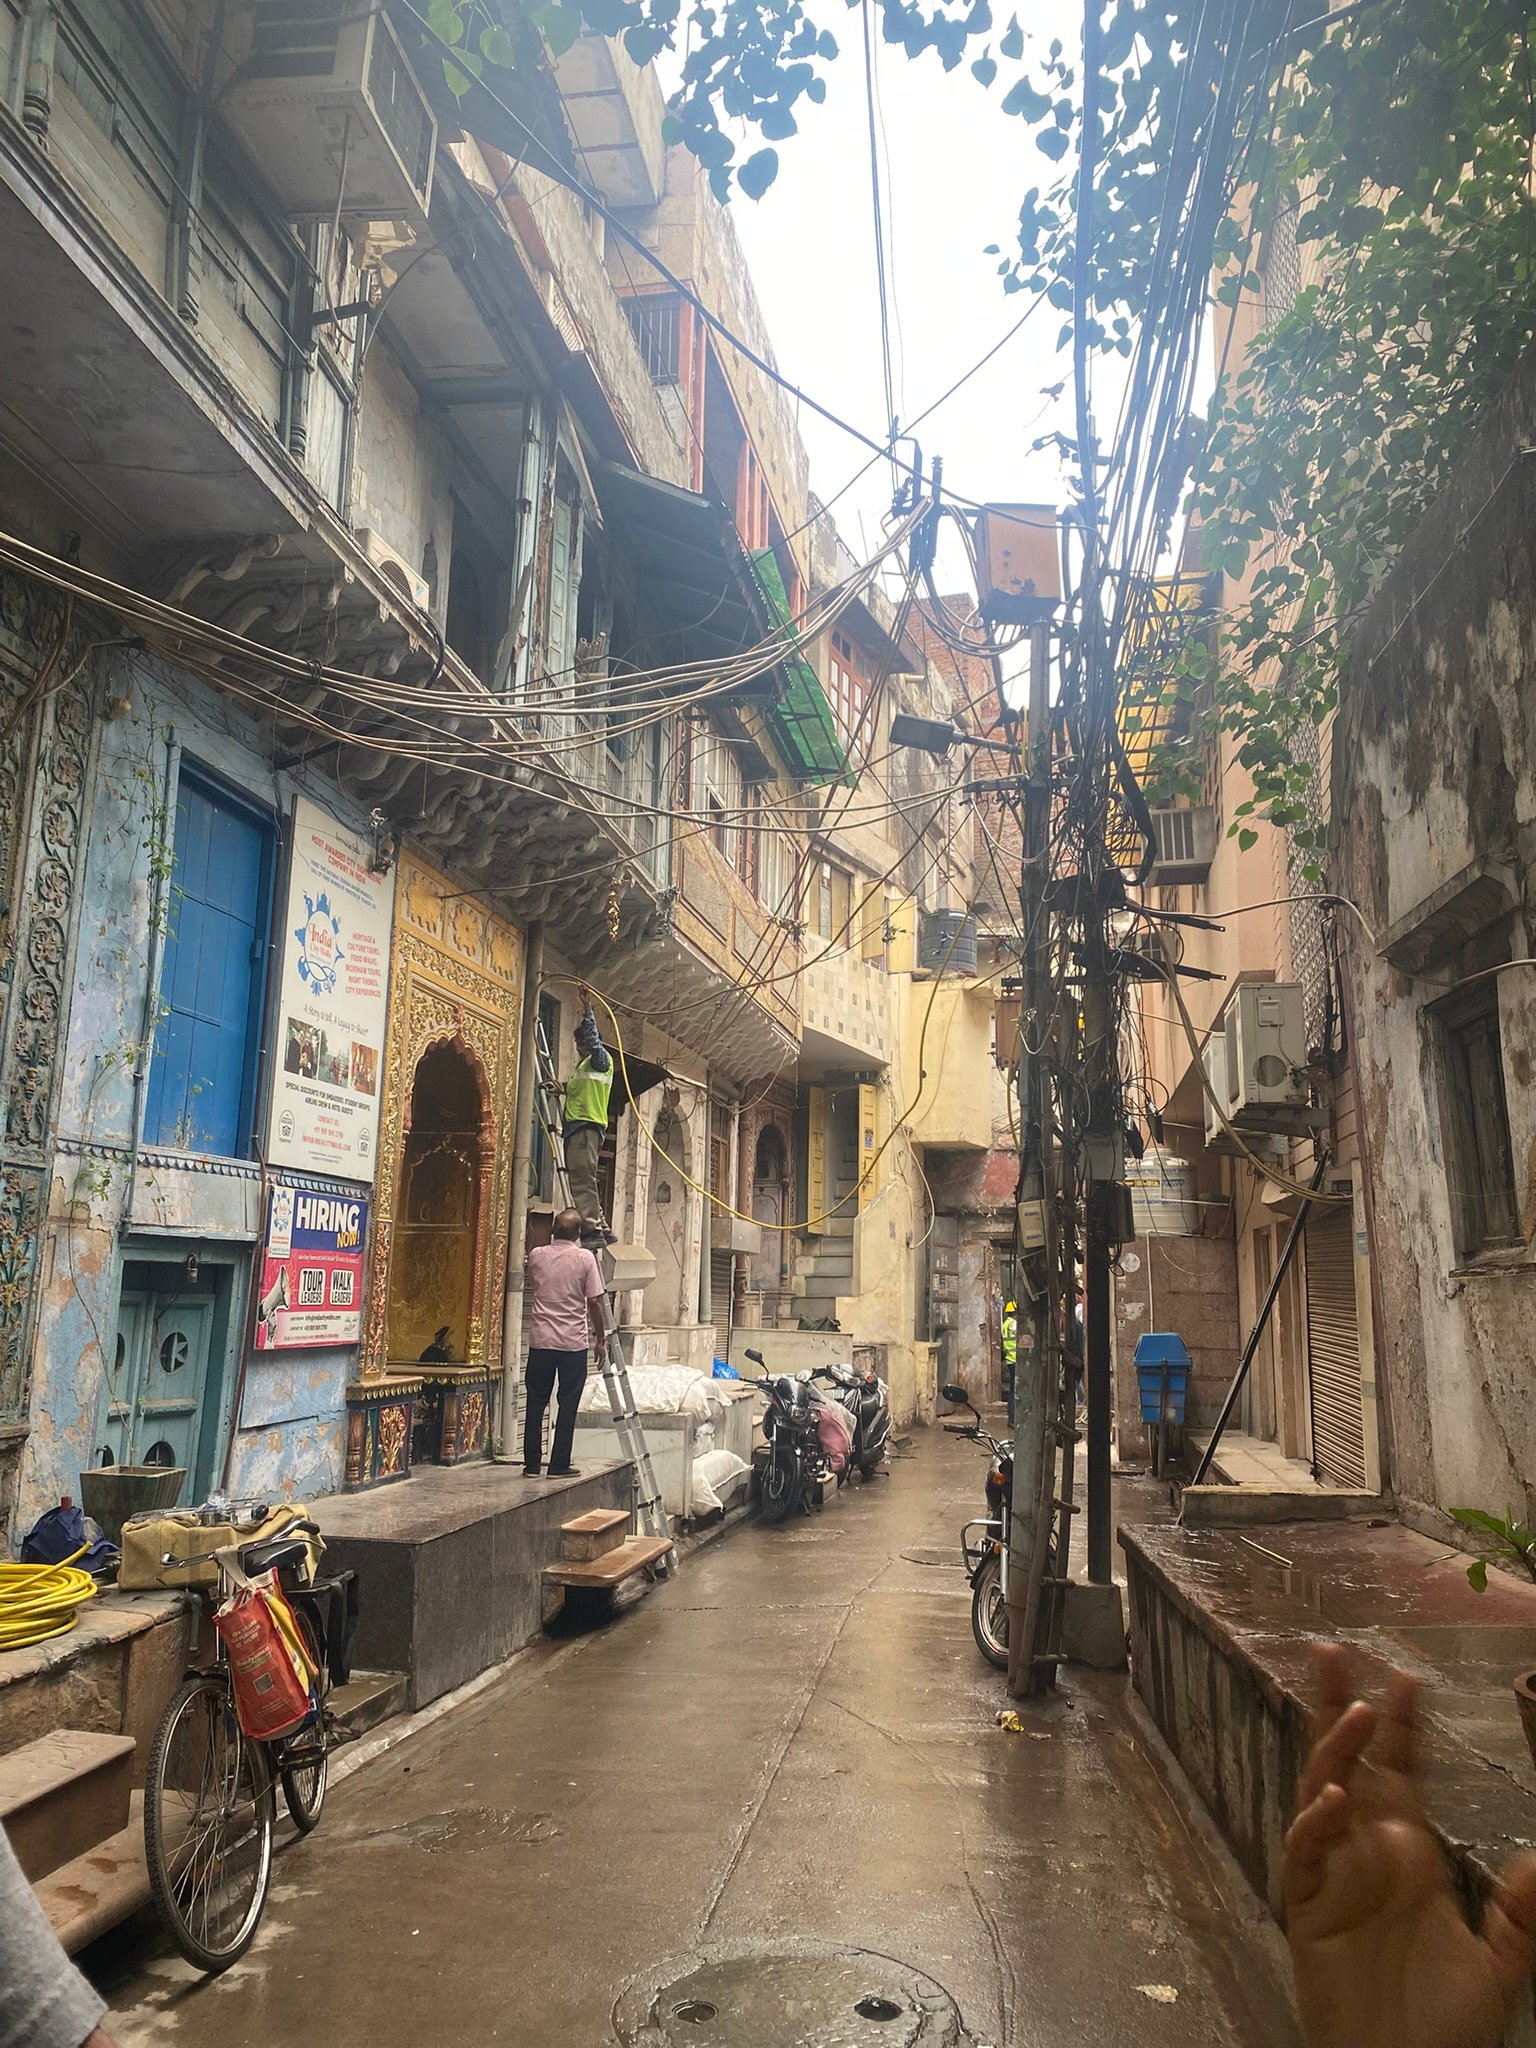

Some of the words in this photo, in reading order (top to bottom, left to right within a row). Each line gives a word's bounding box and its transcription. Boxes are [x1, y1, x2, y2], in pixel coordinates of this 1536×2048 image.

[311, 834, 324, 847] MOST
[325, 843, 346, 862] AWARDED
[346, 857, 356, 868] CITY
[328, 855, 349, 874] COMPANY
[355, 871, 366, 884] INDIA
[309, 923, 332, 950] India
[352, 932, 372, 944] HERITAGE
[347, 942, 366, 953] CULTURE
[351, 954, 363, 963] FOOD
[345, 964, 367, 974] RICKSHAW
[348, 975, 361, 984] NIGHT
[345, 986, 355, 994] CITY
[355, 987, 381, 998] EXPERIENCES
[286, 1081, 299, 1092] SPECIAL
[300, 1085, 319, 1096] DISCOUNTS
[317, 1100, 328, 1109] CREW
[296, 1196, 360, 1233] HIRING
[336, 1230, 360, 1249] NOW!
[303, 1270, 323, 1291] TOUR
[332, 1271, 352, 1291] WALK
[301, 1291, 322, 1304] LEADERS
[331, 1292, 352, 1304] LEADERS
